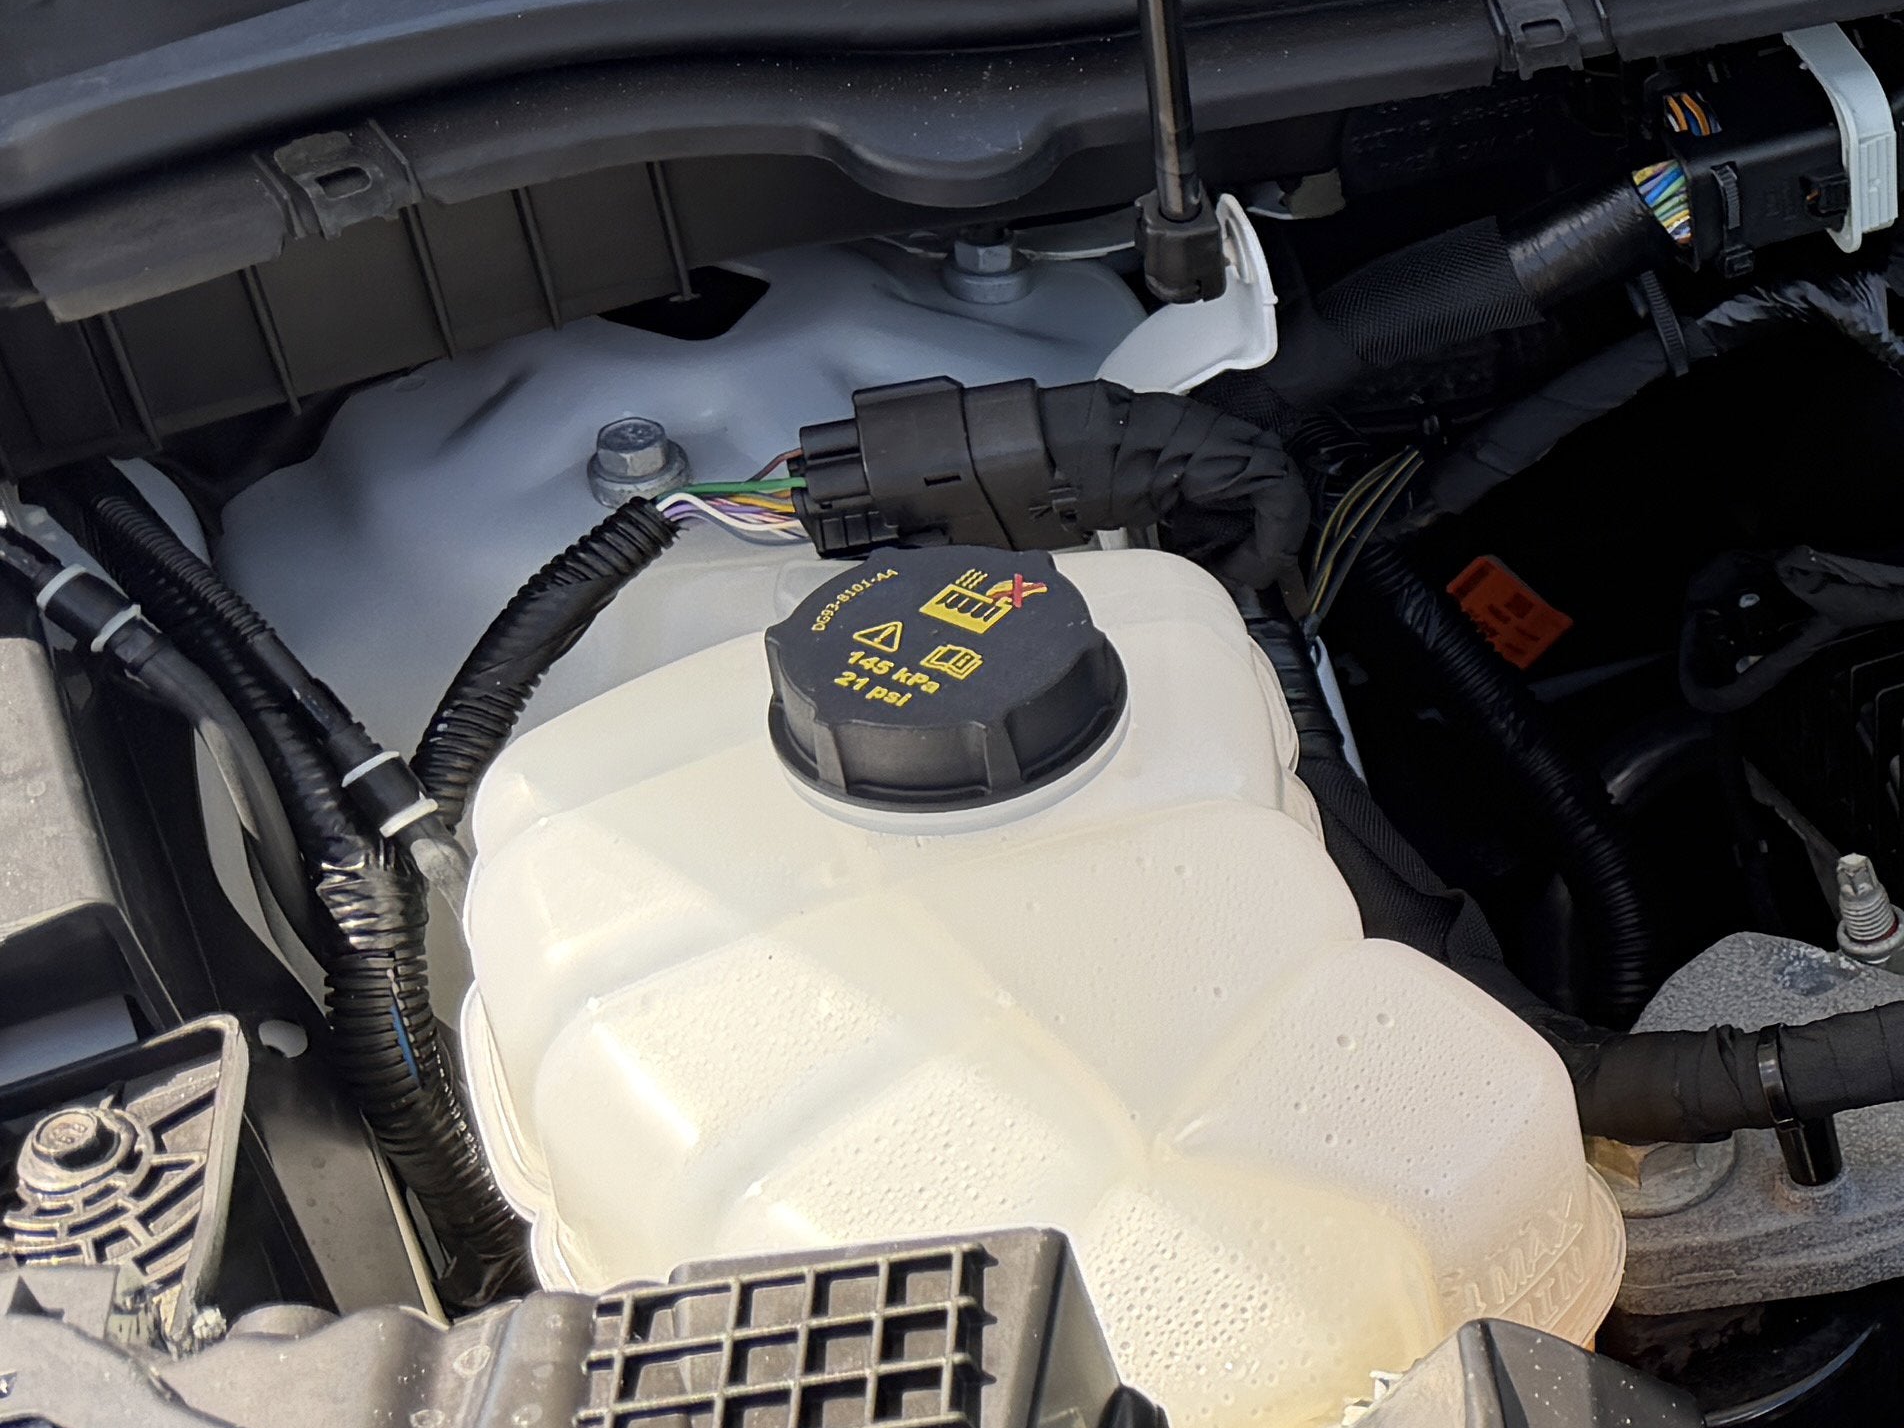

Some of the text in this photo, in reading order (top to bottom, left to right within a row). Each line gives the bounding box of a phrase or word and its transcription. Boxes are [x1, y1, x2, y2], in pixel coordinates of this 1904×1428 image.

[810, 568, 899, 633] DG93-8101-AA
[833, 671, 913, 708] 21 psi
[847, 649, 941, 695] 145 kPa
